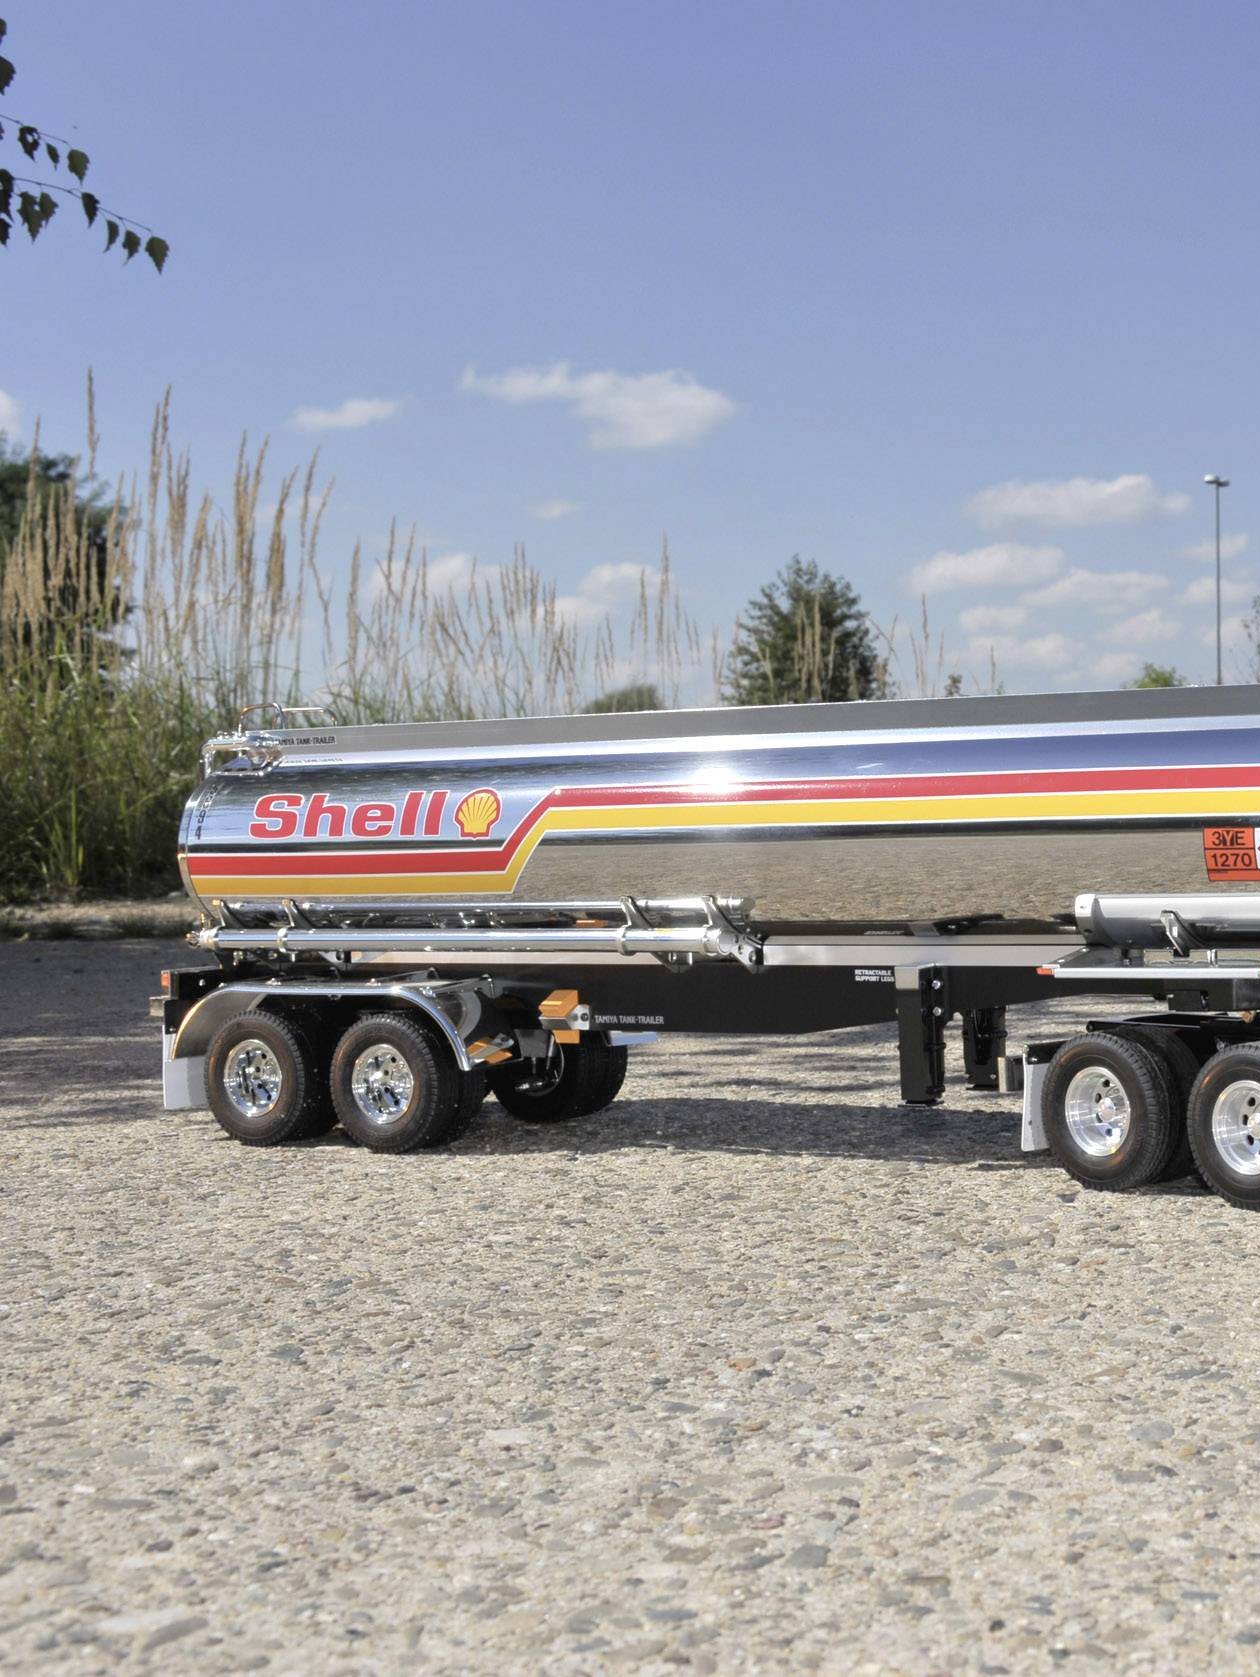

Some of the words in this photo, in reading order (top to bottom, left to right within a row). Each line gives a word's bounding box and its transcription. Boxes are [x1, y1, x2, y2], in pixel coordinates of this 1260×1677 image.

[296, 735, 336, 744] TANK-TRAILER
[249, 790, 450, 839] Shell
[1211, 829, 1246, 847] 3YE
[1211, 852, 1253, 868] 1270
[594, 1014, 618, 1024] TAMIYA
[619, 1015, 665, 1025] TANK-TRAILER
